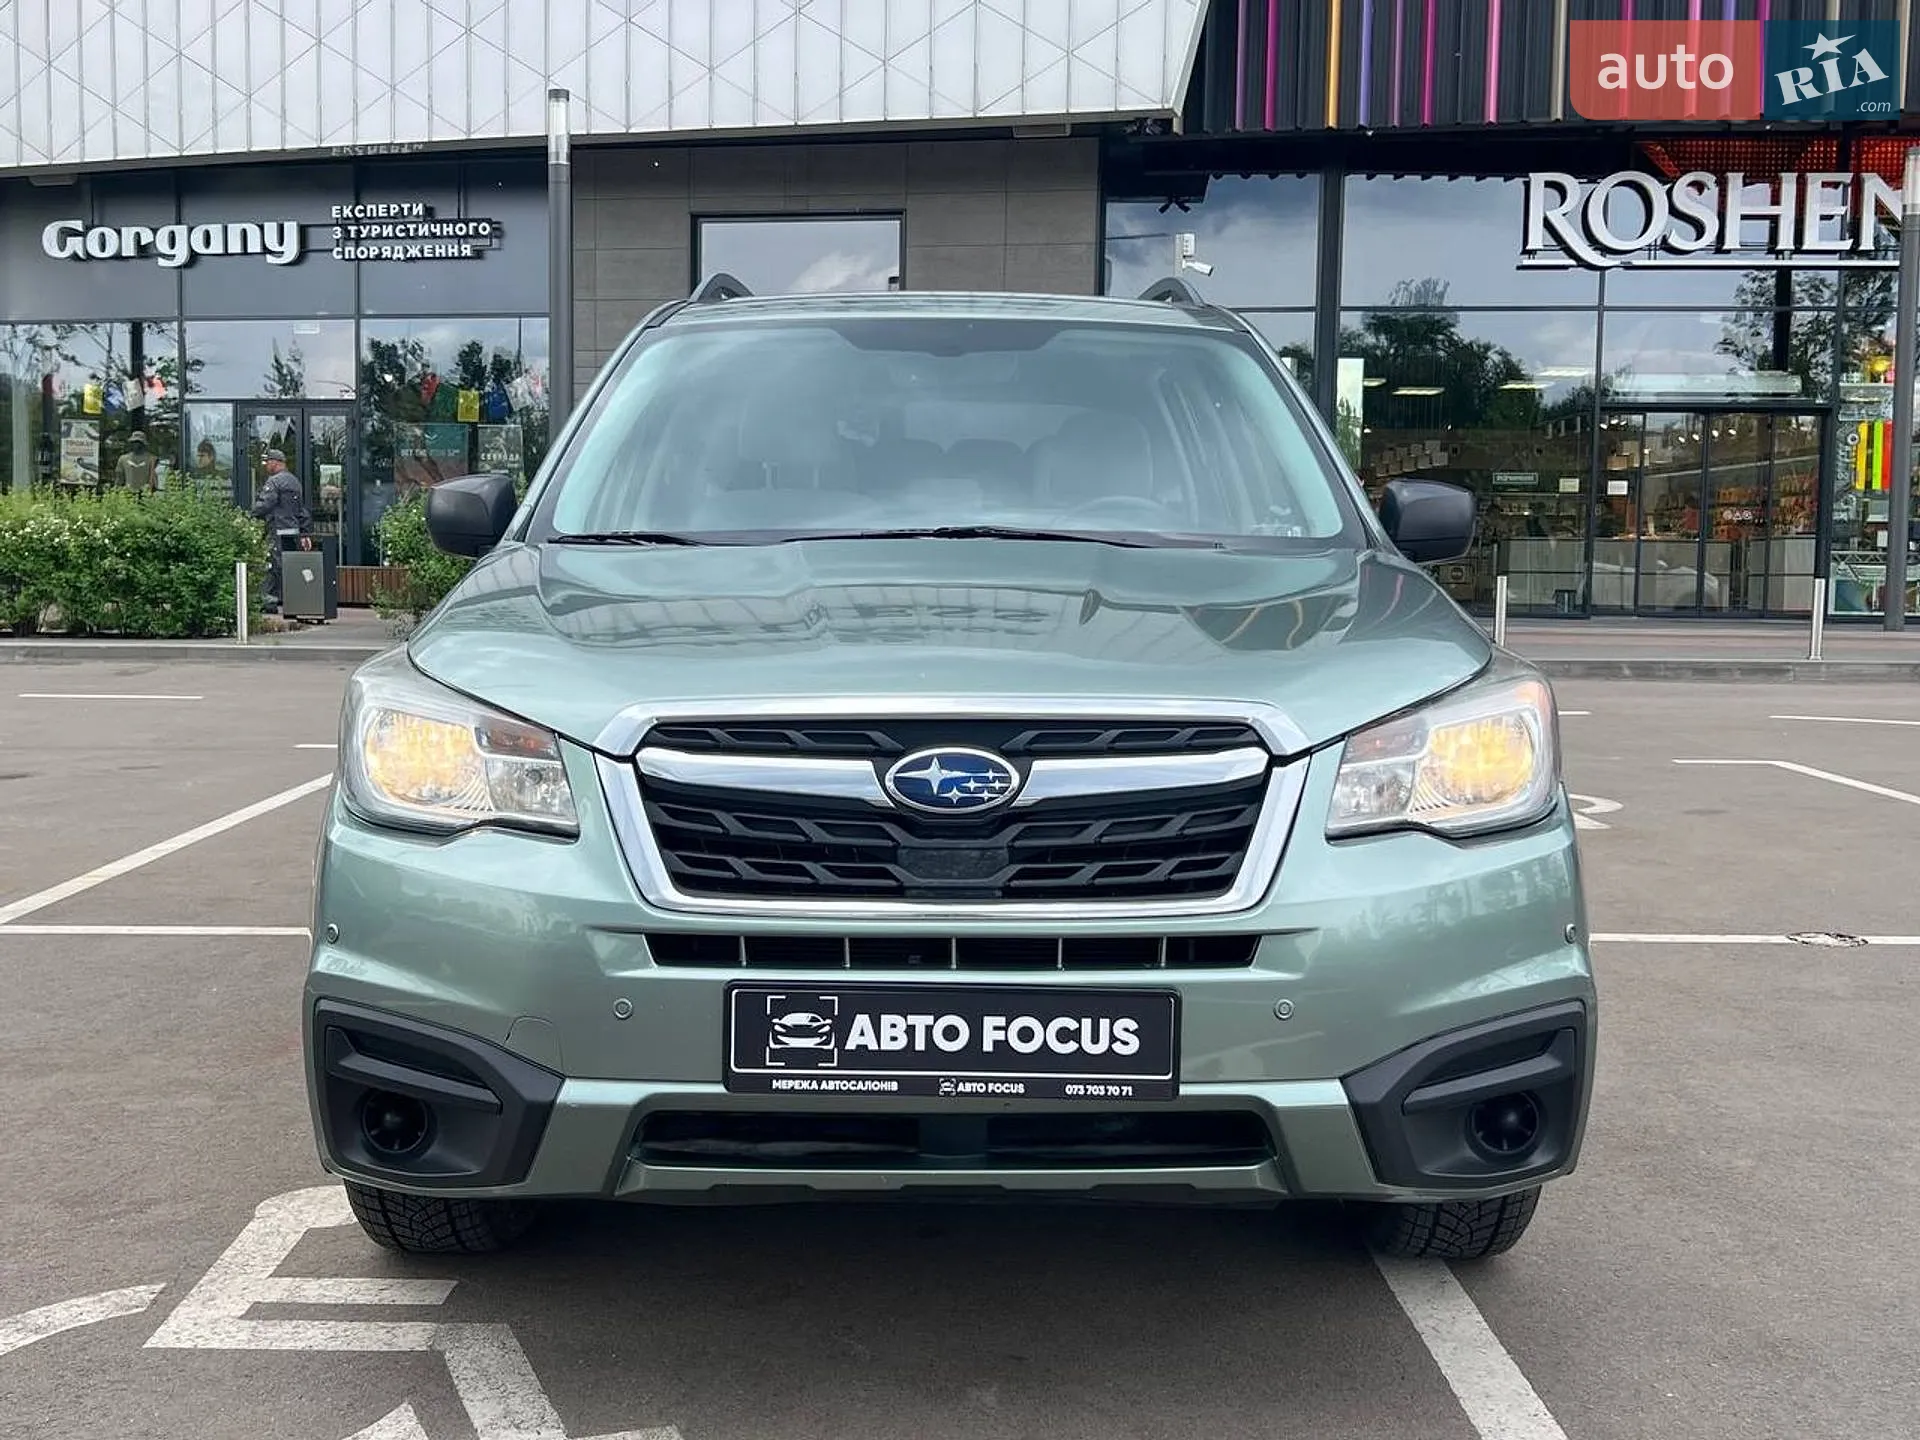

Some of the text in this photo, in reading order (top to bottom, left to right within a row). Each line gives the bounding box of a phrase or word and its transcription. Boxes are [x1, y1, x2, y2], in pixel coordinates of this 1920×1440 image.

[331, 203, 424, 219] ЕКСПЕРТИ
[347, 222, 491, 239] ТУРИСТИЧНОГО
[42, 219, 300, 267] Gorgany
[332, 244, 473, 261] СПОРЯДЖЕННЯ
[844, 1014, 1142, 1056] АВТО FOCUS
[772, 1079, 899, 1092] МЕРЕЖА АВТОСАЛОНІВ
[956, 1082, 1026, 1095] АВТО FOCUS
[1065, 1083, 1134, 1097] 073 703 70 71
